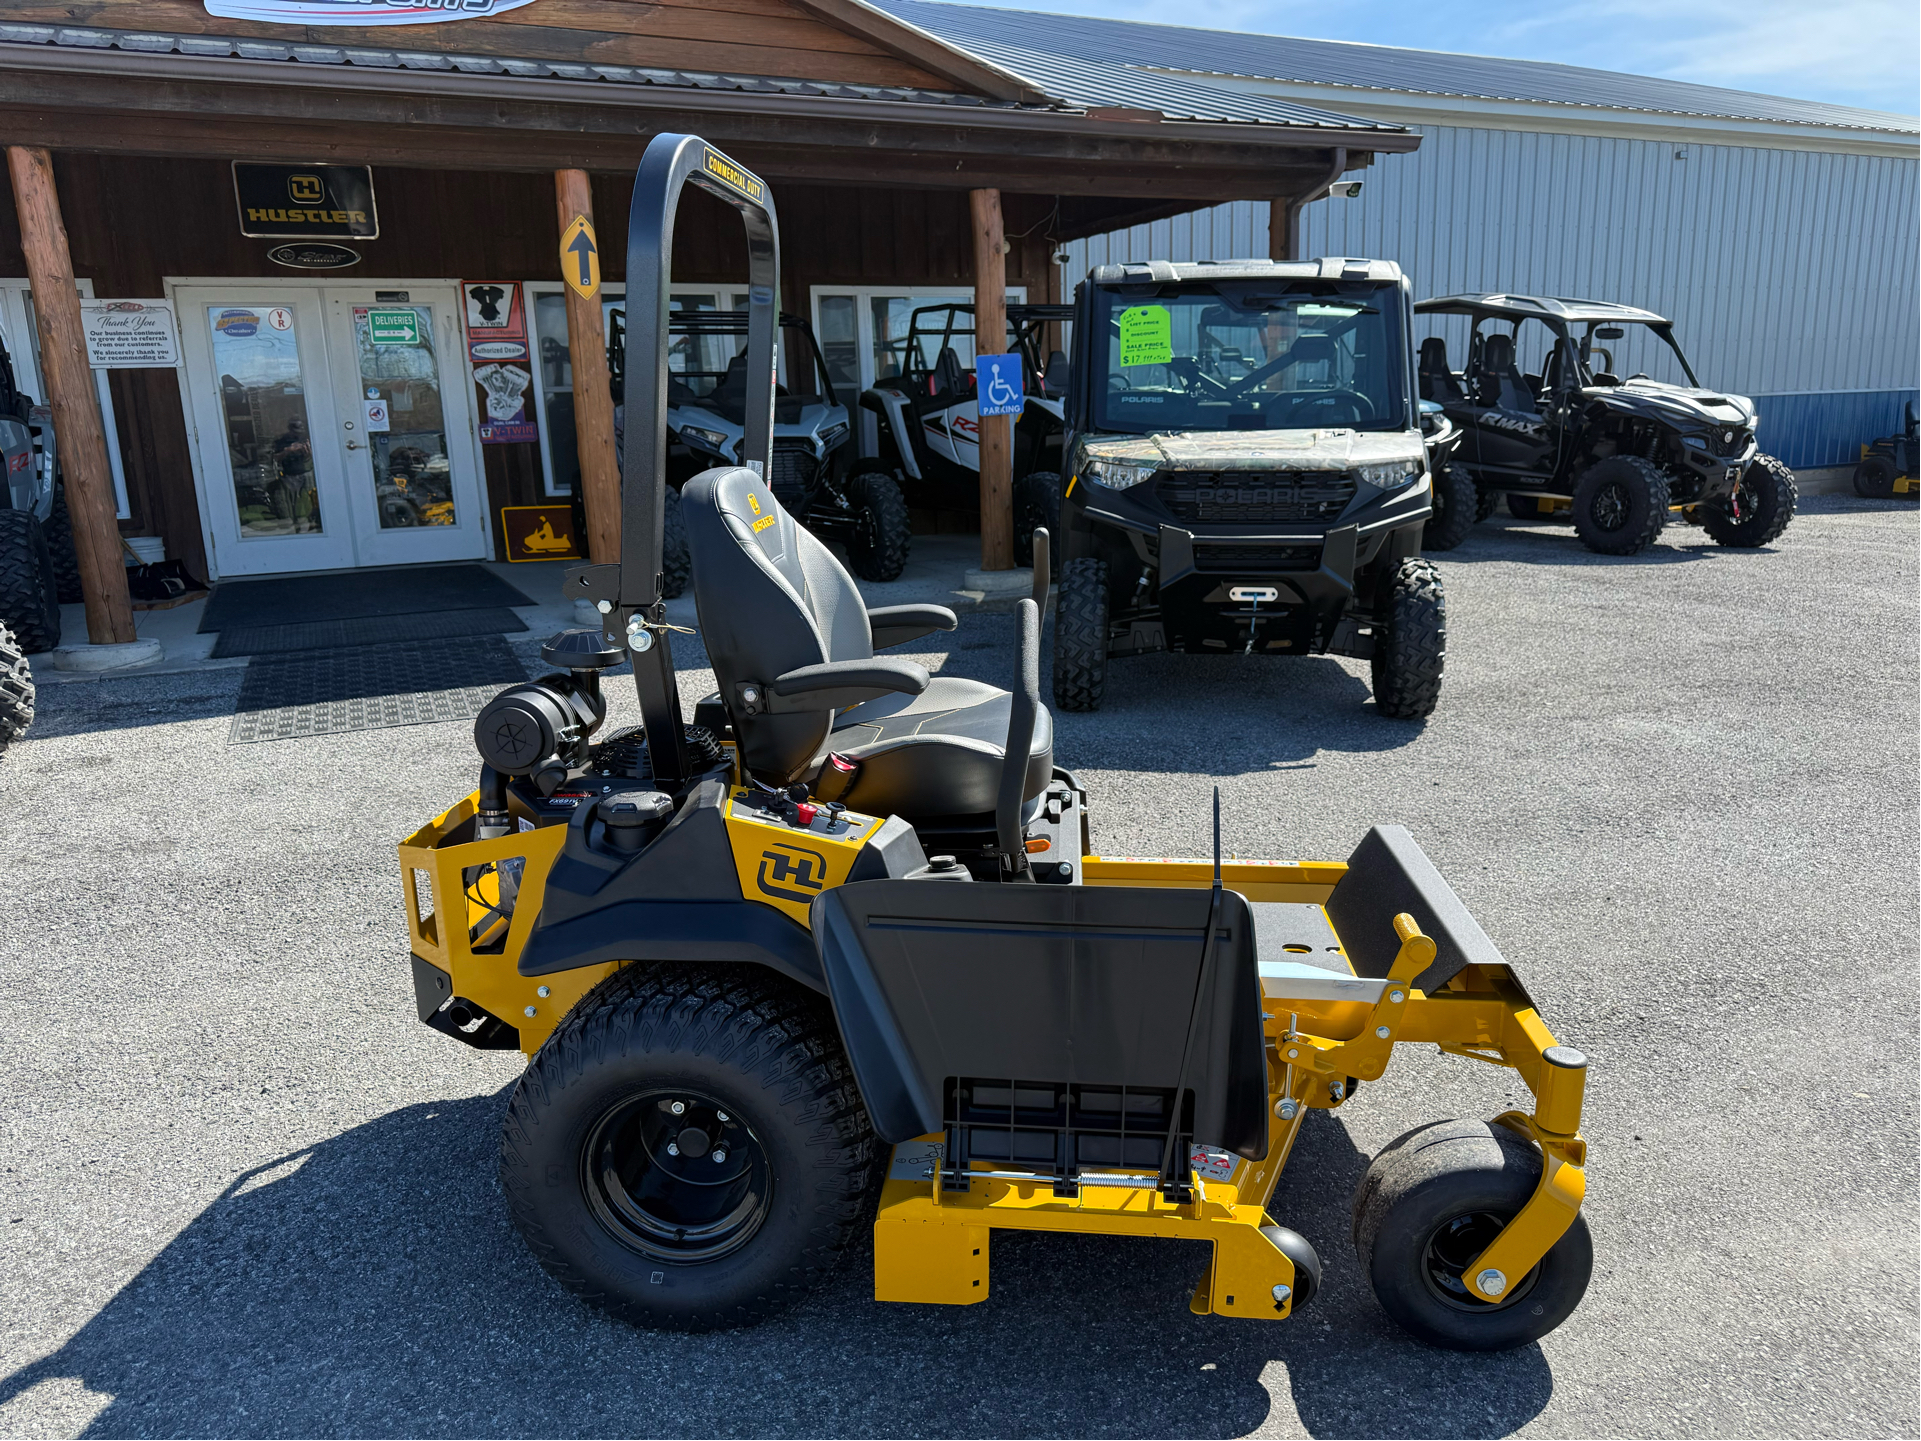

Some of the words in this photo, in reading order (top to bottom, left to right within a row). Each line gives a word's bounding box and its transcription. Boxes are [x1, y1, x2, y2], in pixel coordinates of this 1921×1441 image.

[708, 155, 746, 190] COMMERCIAL
[747, 180, 761, 198] DUTY
[247, 208, 367, 223] HUSTLER
[276, 311, 283, 319] V
[374, 315, 413, 325] DELIVERIES
[97, 315, 130, 329] Thank
[131, 315, 156, 331] You
[277, 319, 285, 328] R
[983, 404, 1021, 415] PARKING
[1478, 411, 1540, 435] RMAX
[494, 426, 534, 435] V-TWIN
[1195, 487, 1319, 504] POLARIS
